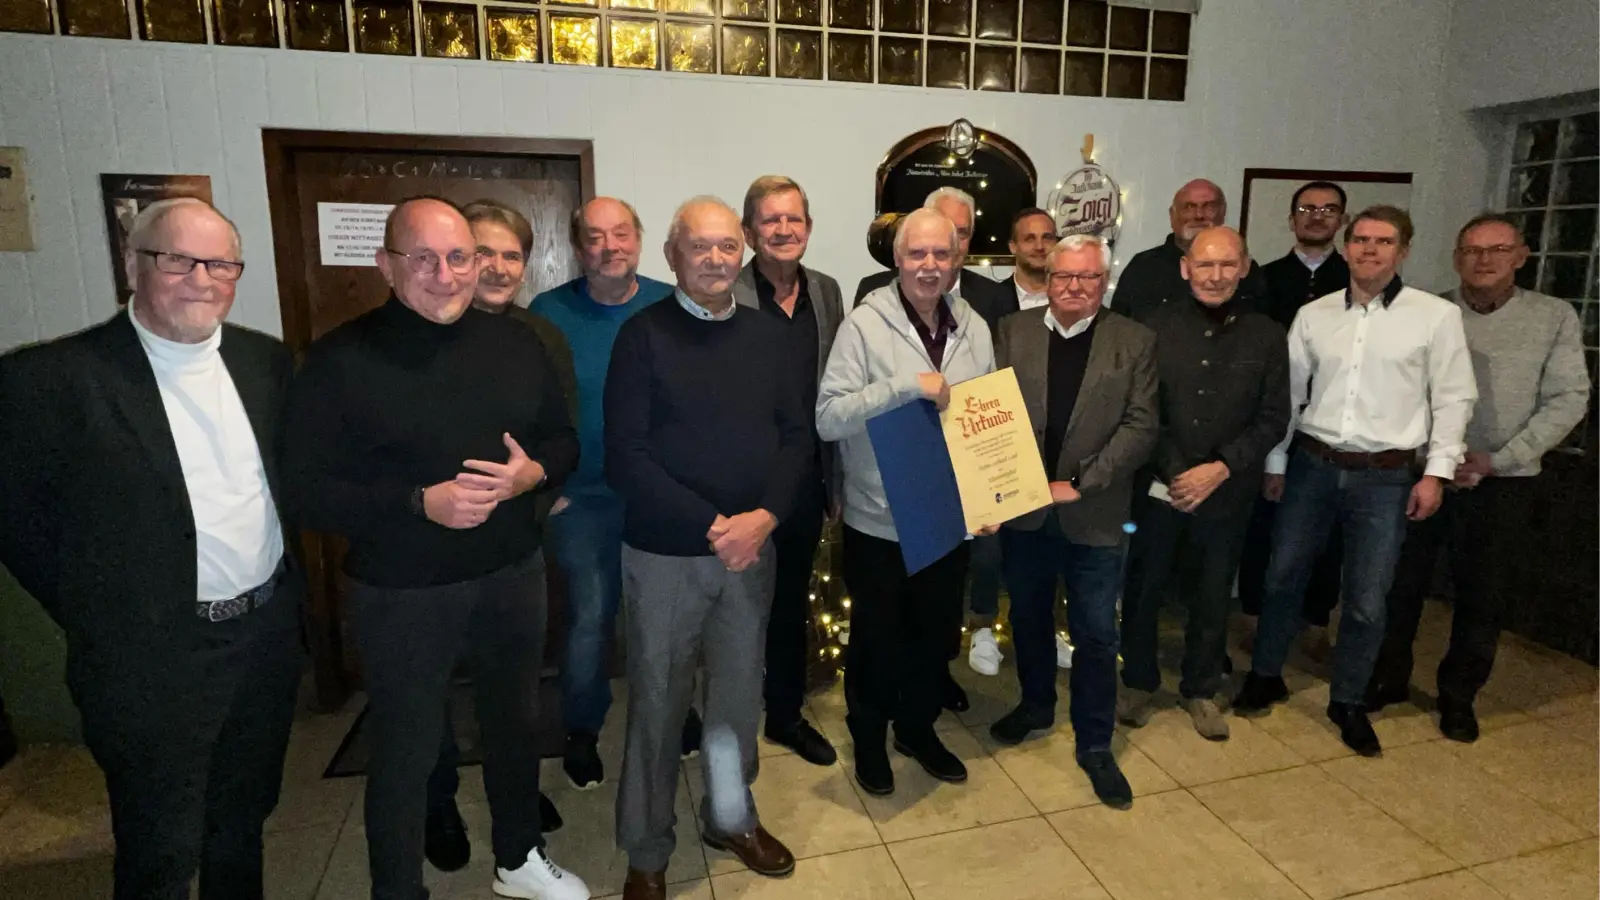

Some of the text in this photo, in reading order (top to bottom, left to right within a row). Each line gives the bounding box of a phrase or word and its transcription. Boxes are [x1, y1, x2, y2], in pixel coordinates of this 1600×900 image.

[1060, 191, 1113, 229] Zoigl
[964, 395, 1001, 414] Ehren
[954, 410, 1015, 439] Urkunde
